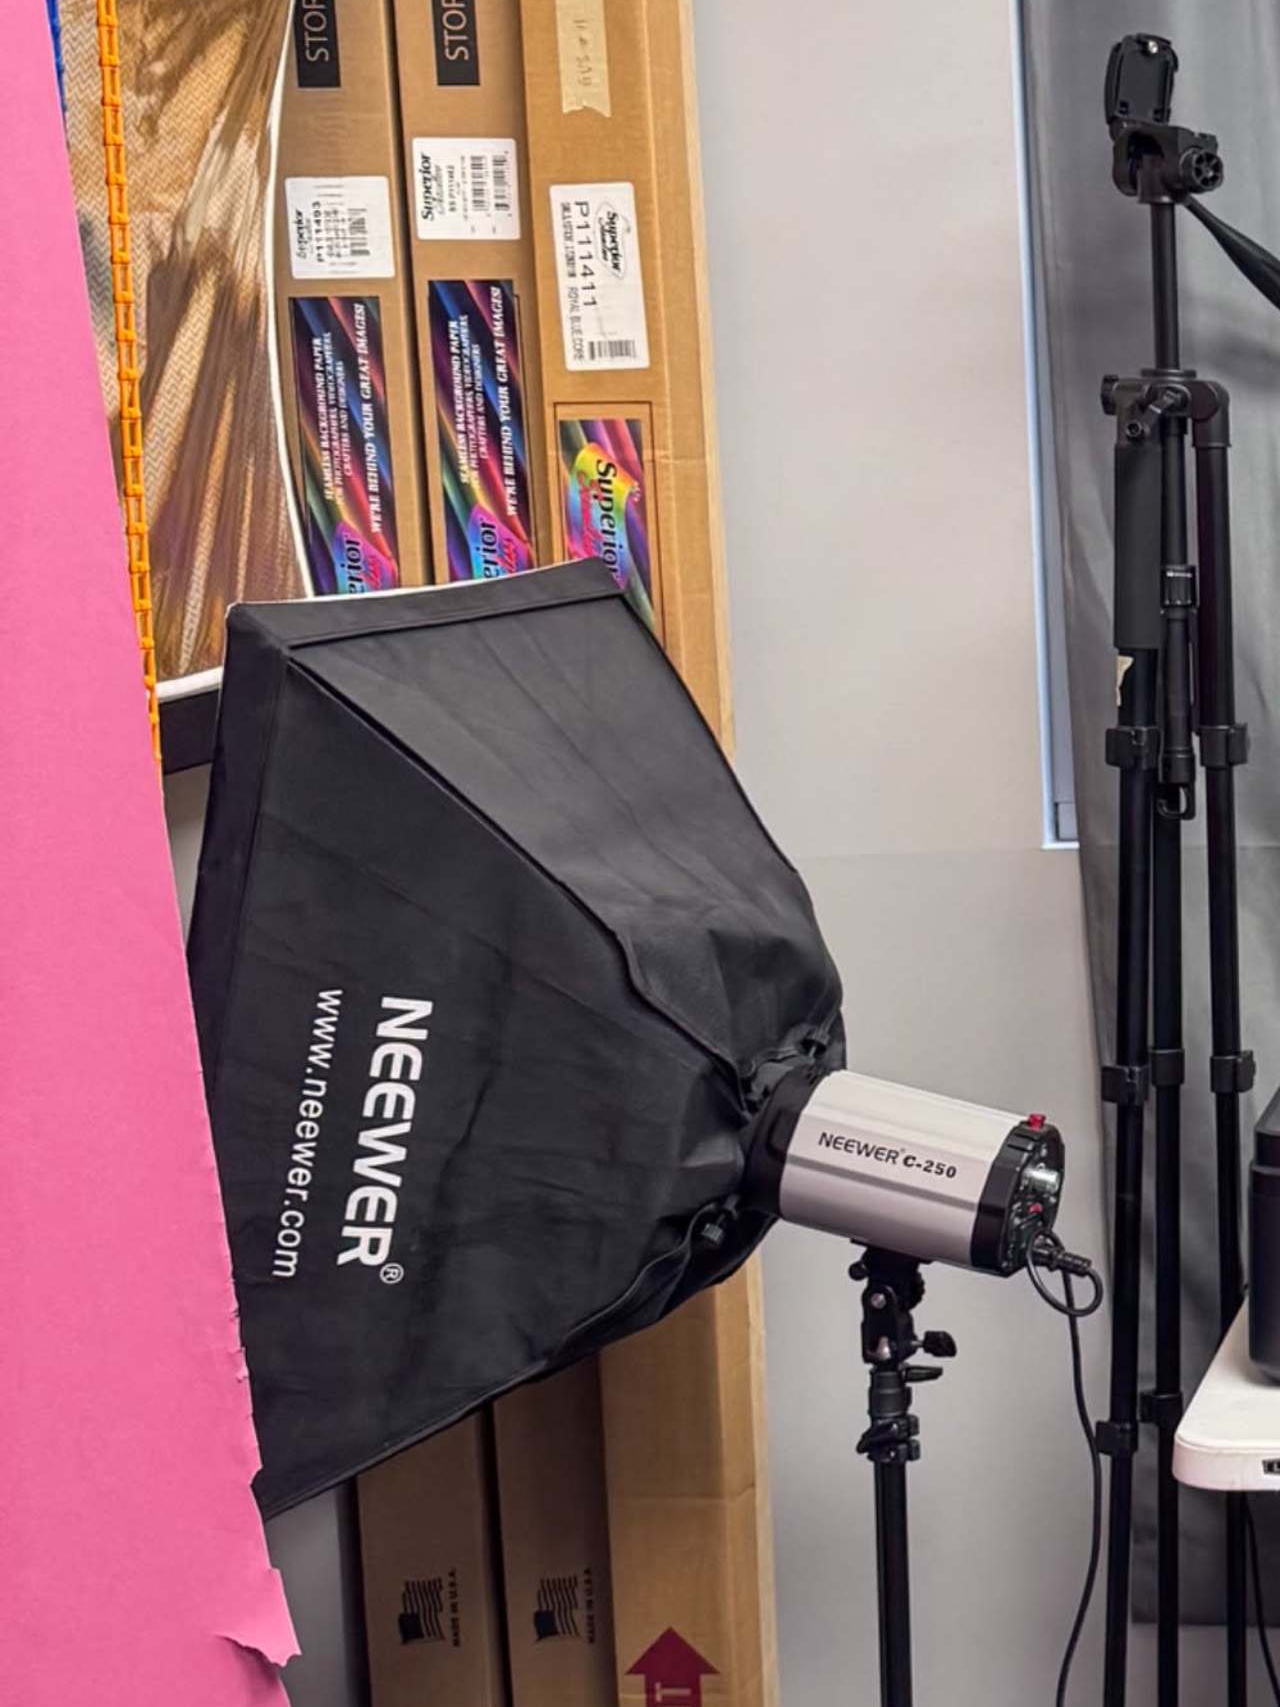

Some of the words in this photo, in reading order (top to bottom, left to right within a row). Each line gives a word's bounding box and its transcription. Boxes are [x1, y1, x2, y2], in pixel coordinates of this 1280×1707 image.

[419, 153, 438, 221] Superior
[575, 201, 598, 307] P111411
[357, 356, 372, 399] GREAT
[494, 340, 507, 382] GREAT
[315, 373, 330, 448] BACKGROUND
[451, 355, 466, 431] BACKGROUND
[498, 386, 511, 422] YOUR
[361, 403, 375, 439] YOUR
[364, 444, 378, 492] BEHIND
[501, 426, 514, 475] BEHIND
[272, 989, 342, 1279] www.neewer.com
[818, 1131, 901, 1165] NEEWER
[902, 1154, 957, 1179] C-250
